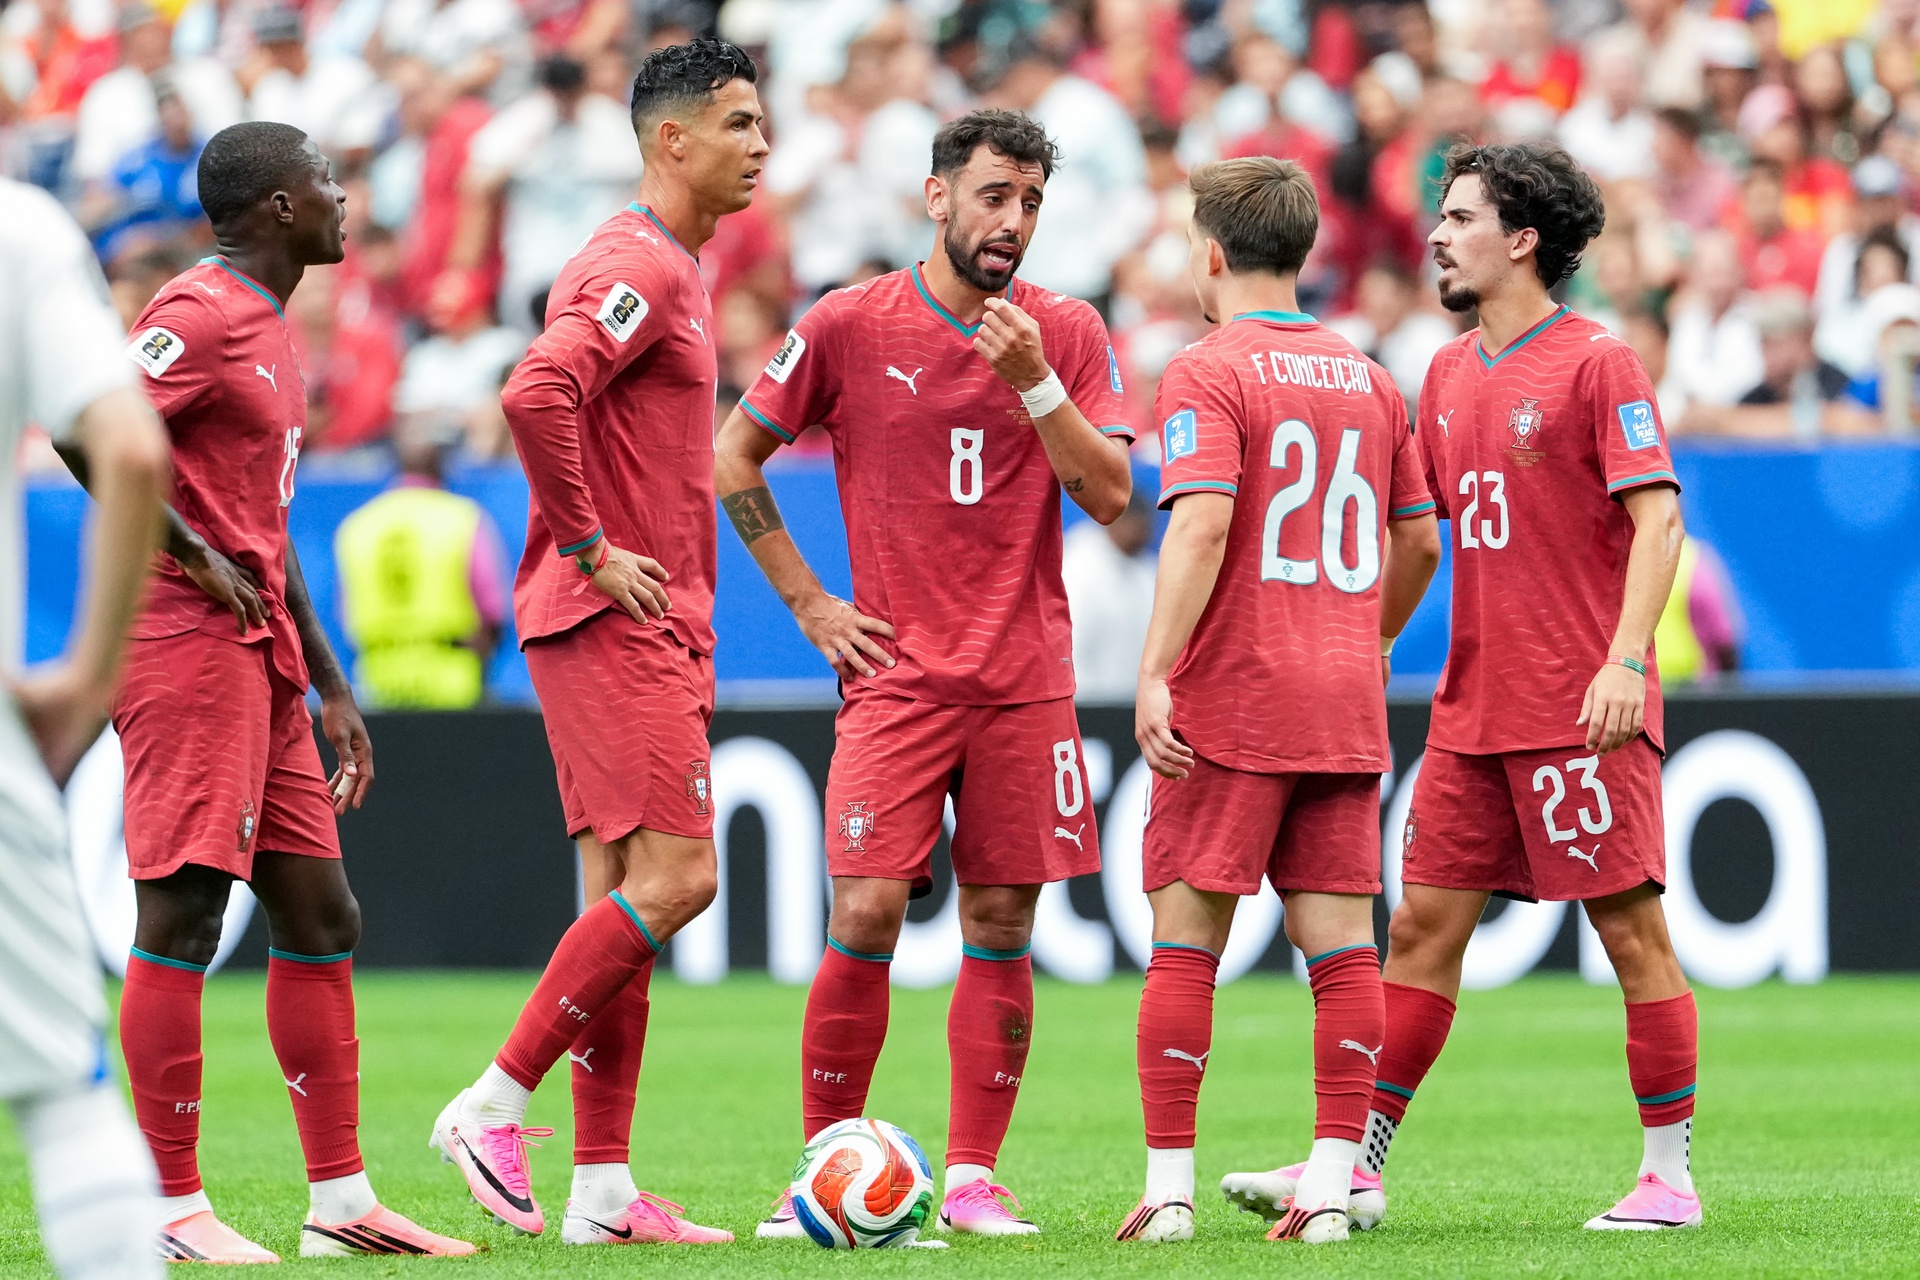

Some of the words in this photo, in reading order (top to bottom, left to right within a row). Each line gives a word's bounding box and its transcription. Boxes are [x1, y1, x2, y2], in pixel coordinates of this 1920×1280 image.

[1250, 353, 1267, 385] F
[1269, 351, 1372, 394] CONCEIÇÃO
[949, 427, 984, 505] 8
[1261, 418, 1380, 594] 26
[1459, 470, 1510, 550] 23
[1052, 737, 1085, 819] 8
[1531, 754, 1613, 843] 23
